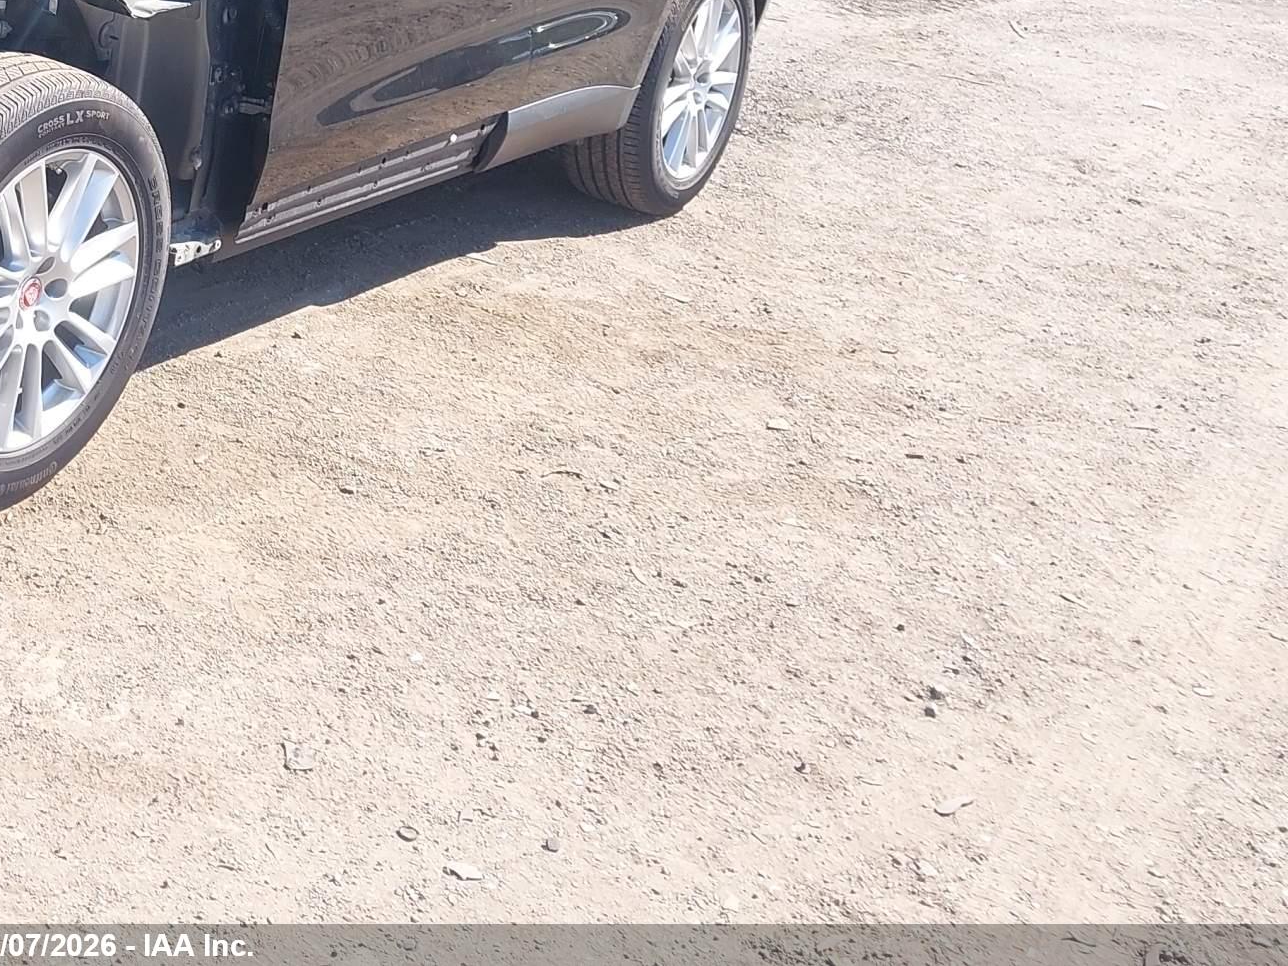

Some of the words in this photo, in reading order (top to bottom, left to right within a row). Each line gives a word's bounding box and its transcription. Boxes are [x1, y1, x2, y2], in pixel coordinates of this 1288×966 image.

[37, 115, 65, 134] CROSS
[66, 110, 84, 125] LX
[86, 110, 110, 120] SPORT
